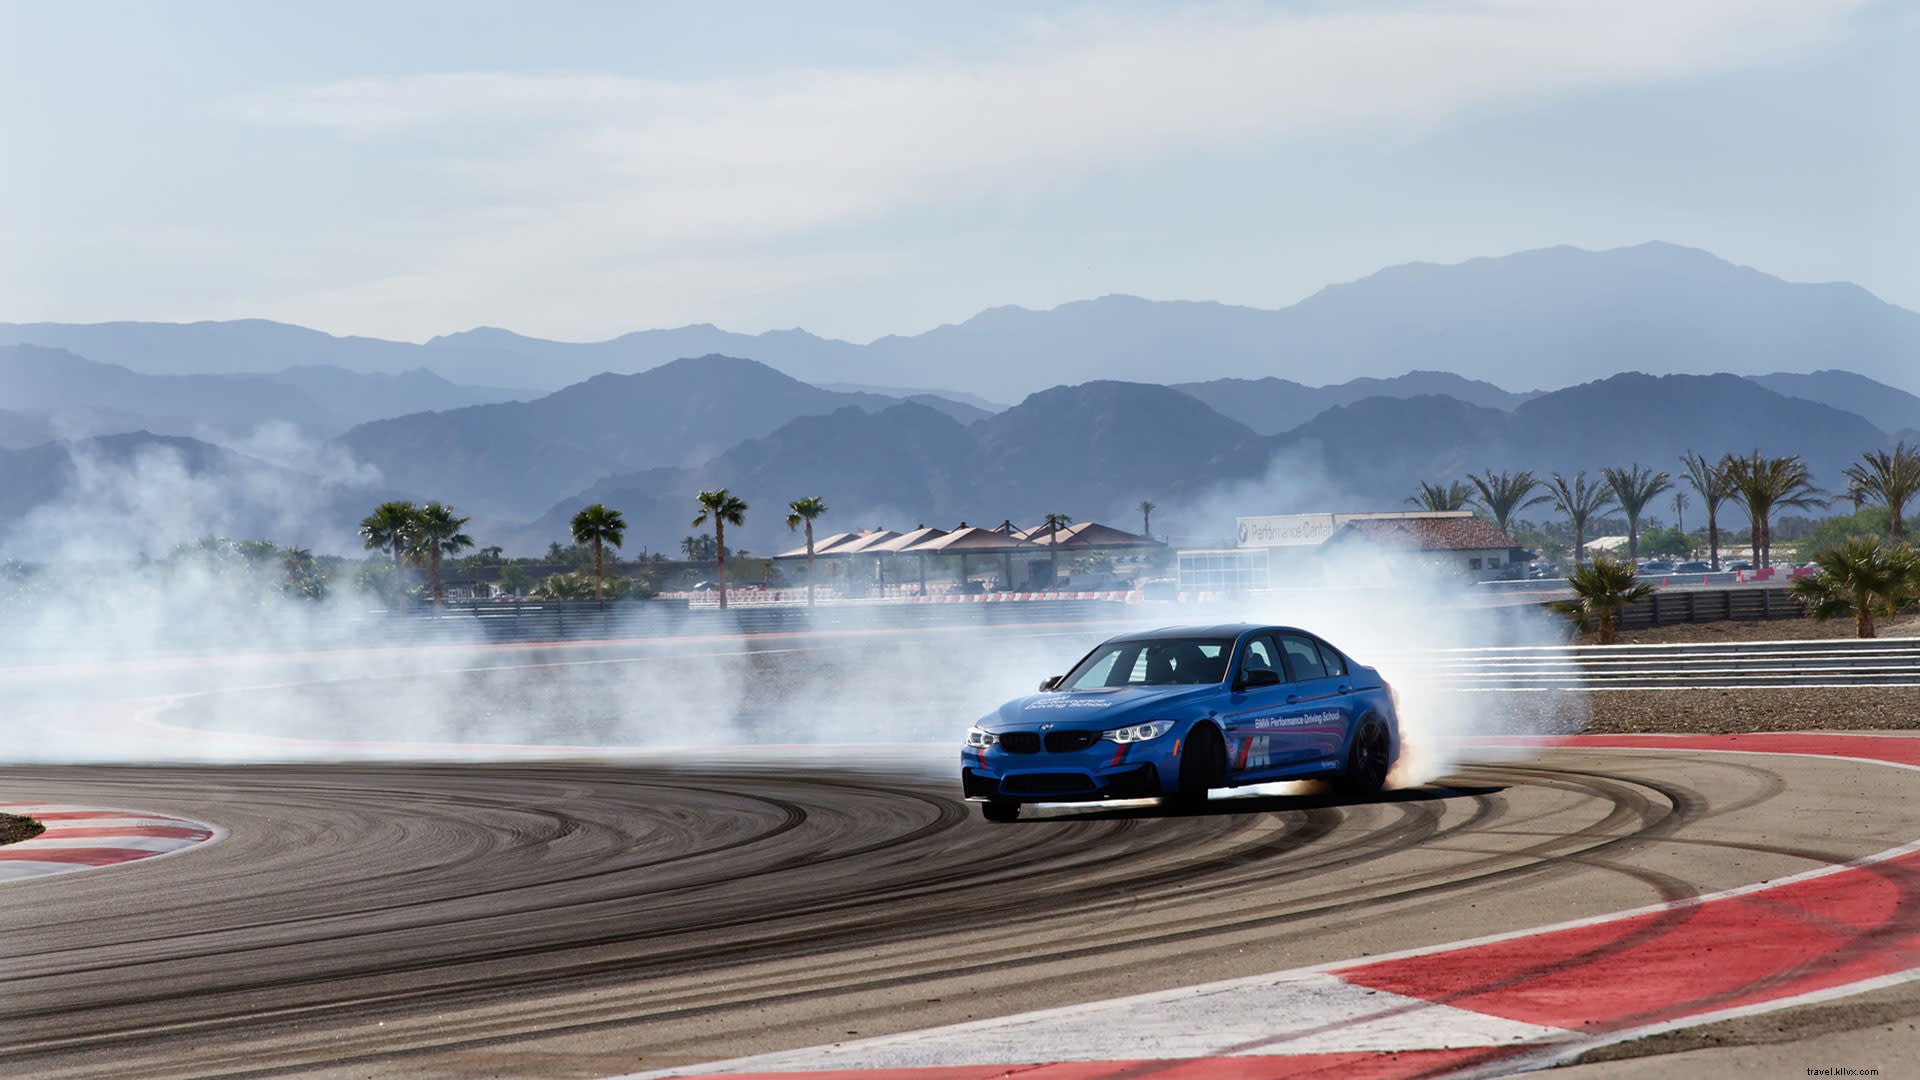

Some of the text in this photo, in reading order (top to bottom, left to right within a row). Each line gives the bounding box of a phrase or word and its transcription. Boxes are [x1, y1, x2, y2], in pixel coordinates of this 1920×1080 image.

[1303, 521, 1331, 538] Center
[1255, 710, 1340, 729] BMW Performance Driving School
